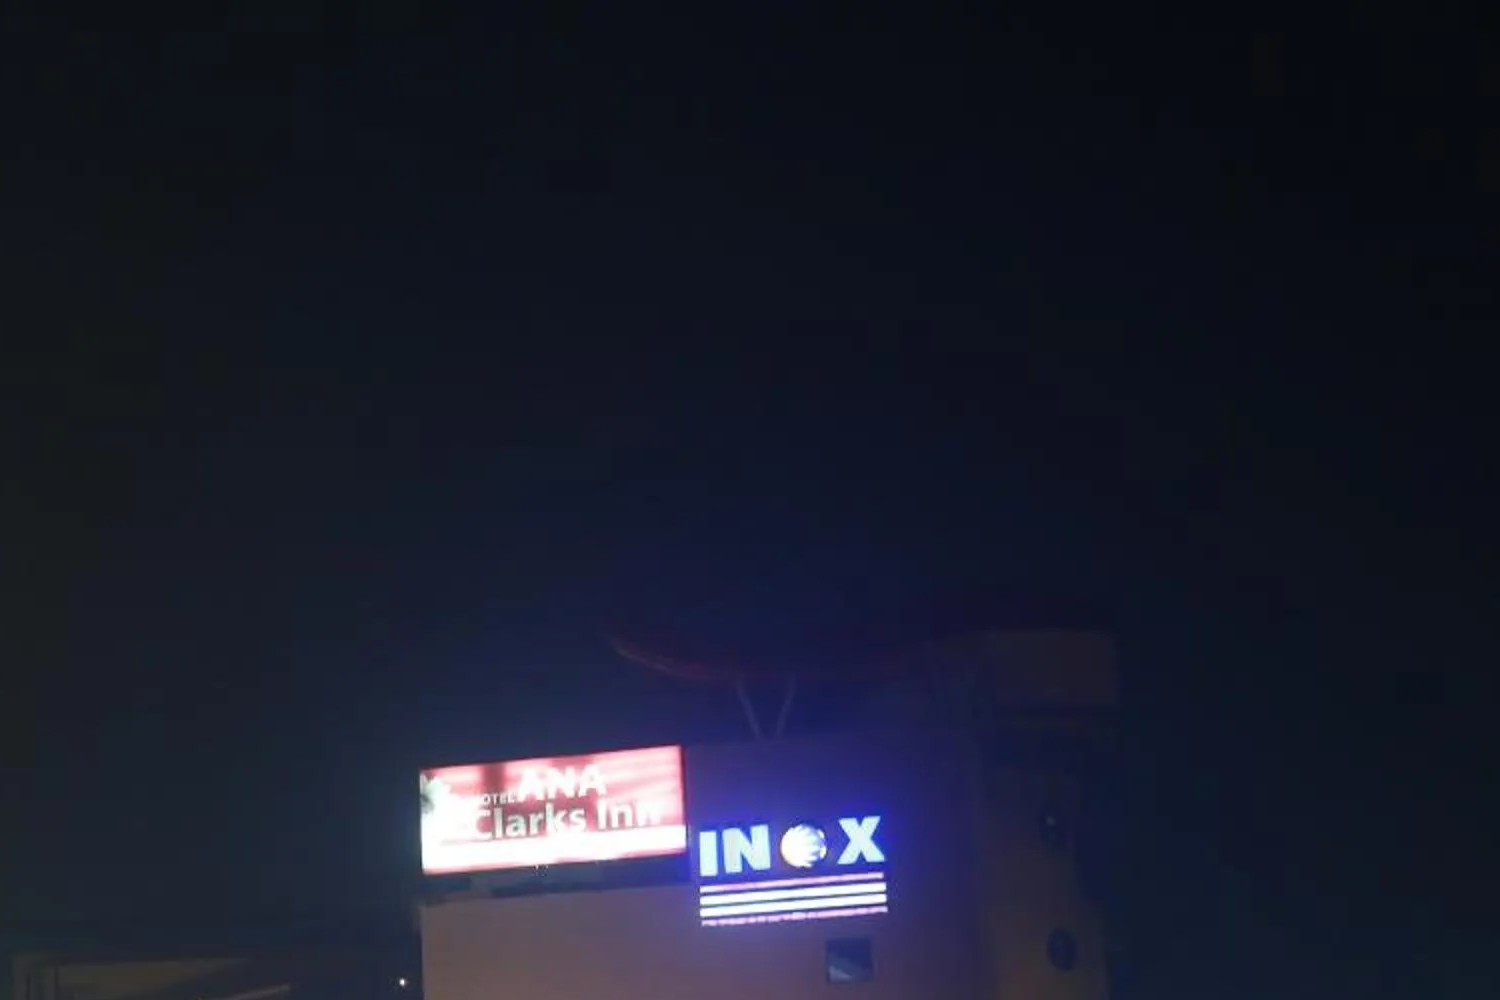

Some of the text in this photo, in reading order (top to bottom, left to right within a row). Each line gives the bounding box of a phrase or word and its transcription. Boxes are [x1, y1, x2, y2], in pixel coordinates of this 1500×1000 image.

[474, 764, 607, 806] OTEL ANA
[471, 797, 662, 841] Clarks Inn
[700, 815, 885, 876] INOX
